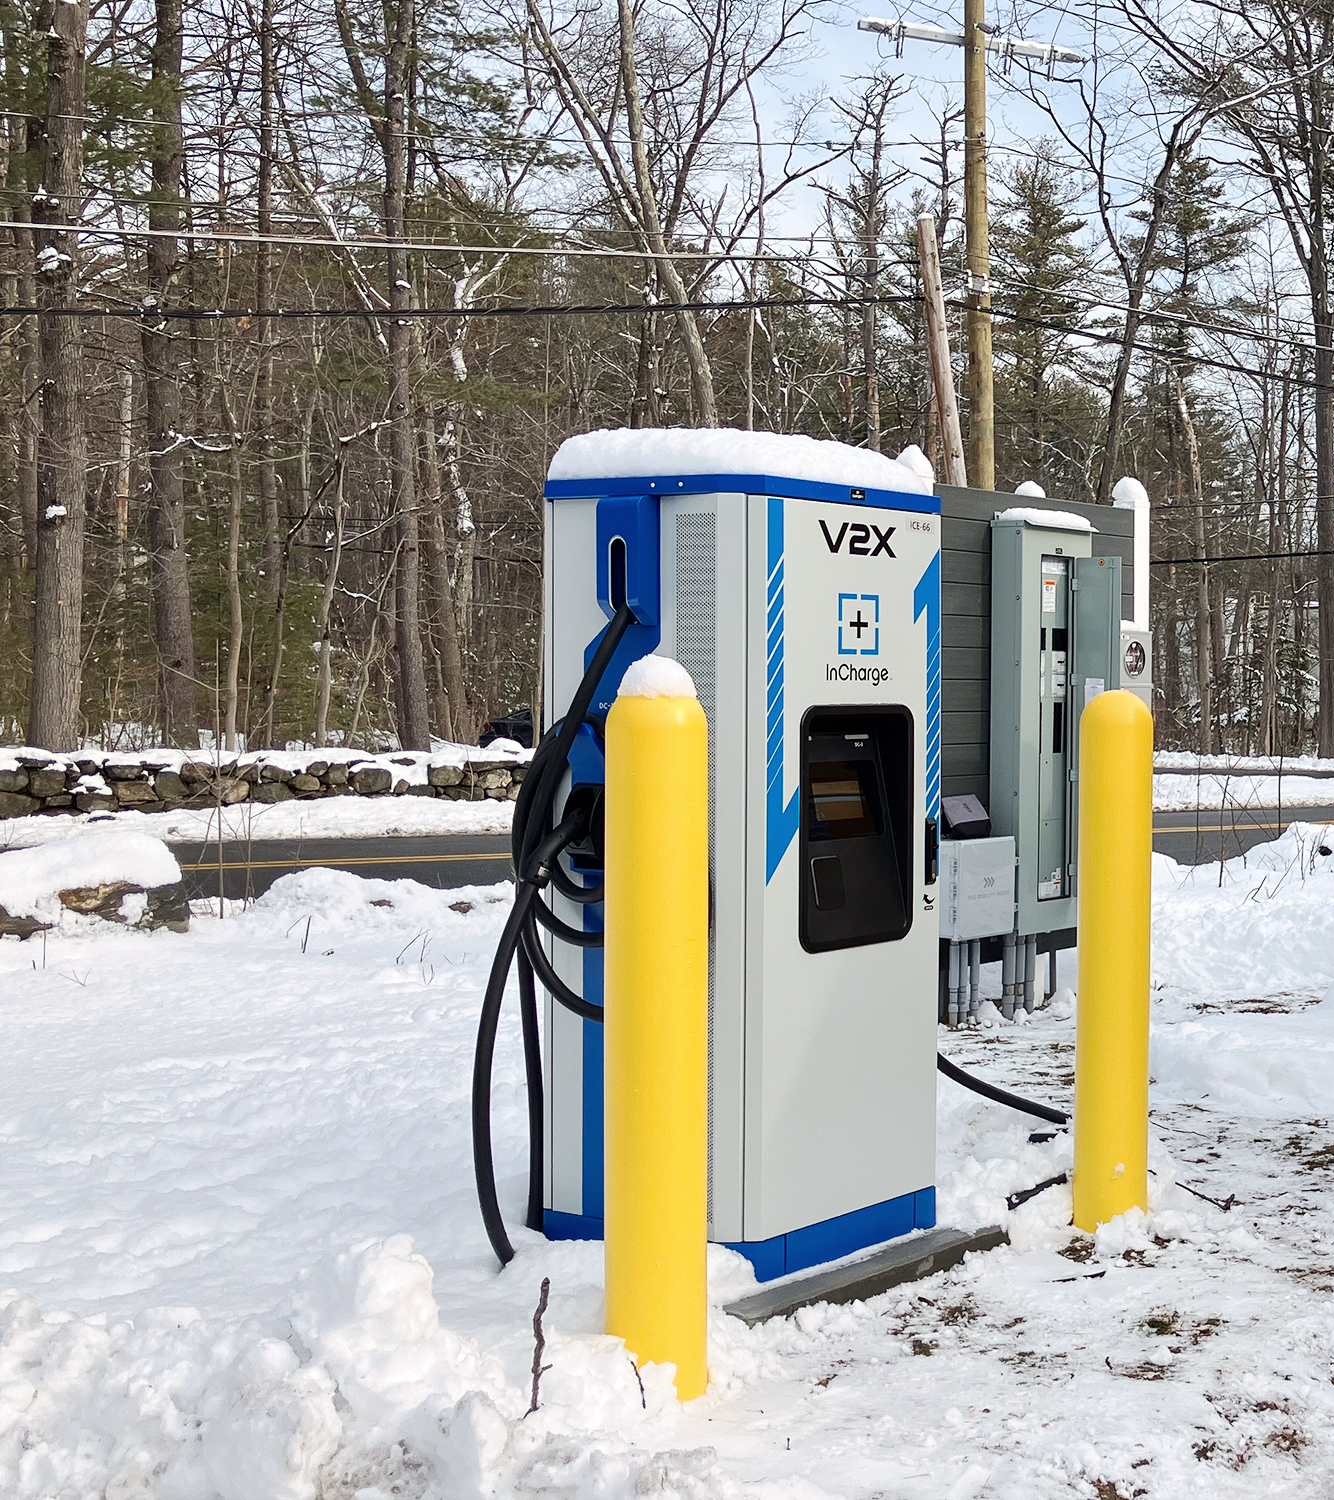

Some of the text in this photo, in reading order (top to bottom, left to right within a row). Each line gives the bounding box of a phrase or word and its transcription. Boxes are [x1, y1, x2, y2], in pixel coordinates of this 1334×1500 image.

[910, 521, 931, 531] ICE-66
[818, 519, 897, 558] V2X
[826, 663, 889, 686] InCharge
